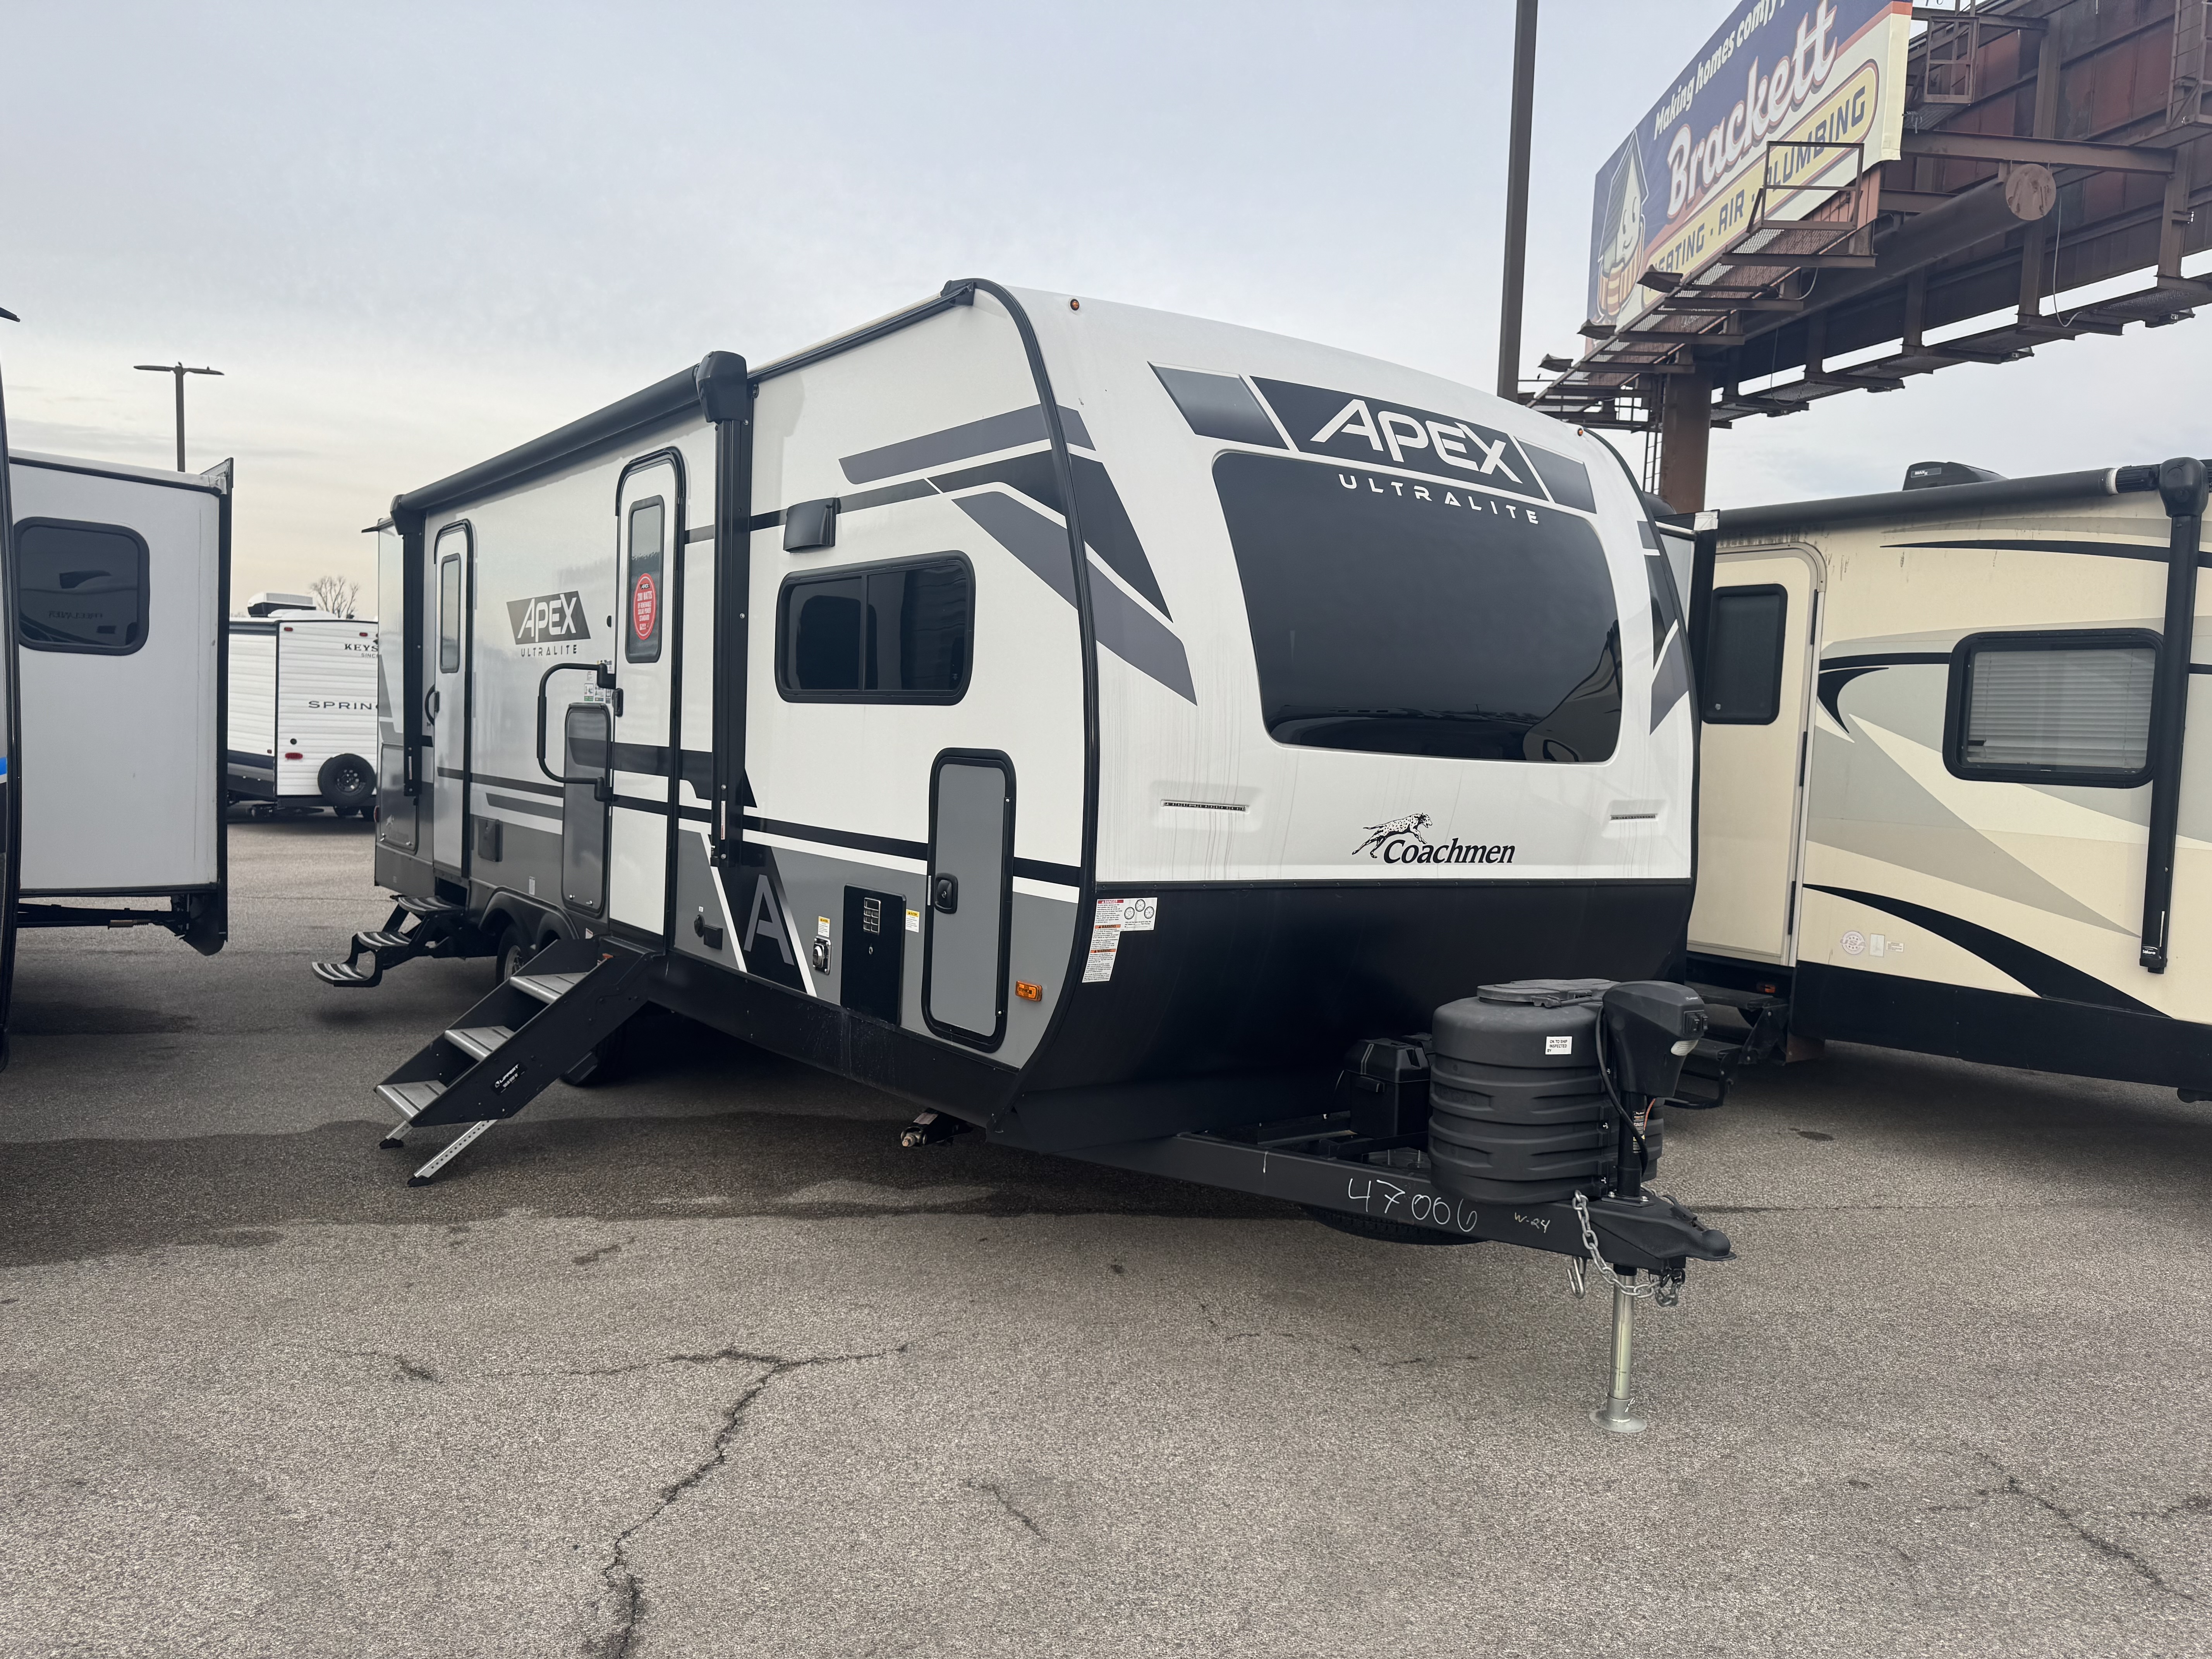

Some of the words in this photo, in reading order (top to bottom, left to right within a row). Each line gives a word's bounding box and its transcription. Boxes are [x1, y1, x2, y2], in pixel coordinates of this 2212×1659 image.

[1654, 76, 1695, 141] Making
[1695, 31, 1736, 94] homes
[1667, 0, 1838, 219] Brackett
[1655, 223, 1705, 272] EATING
[1718, 189, 1744, 235] AIR
[1310, 399, 1523, 484] APEX
[1339, 474, 1539, 525] ULTRALITE
[517, 594, 577, 642] APEX
[521, 644, 577, 657] ULTRALITE
[309, 701, 378, 710] SPRIN
[1384, 838, 1515, 864] Coachmen
